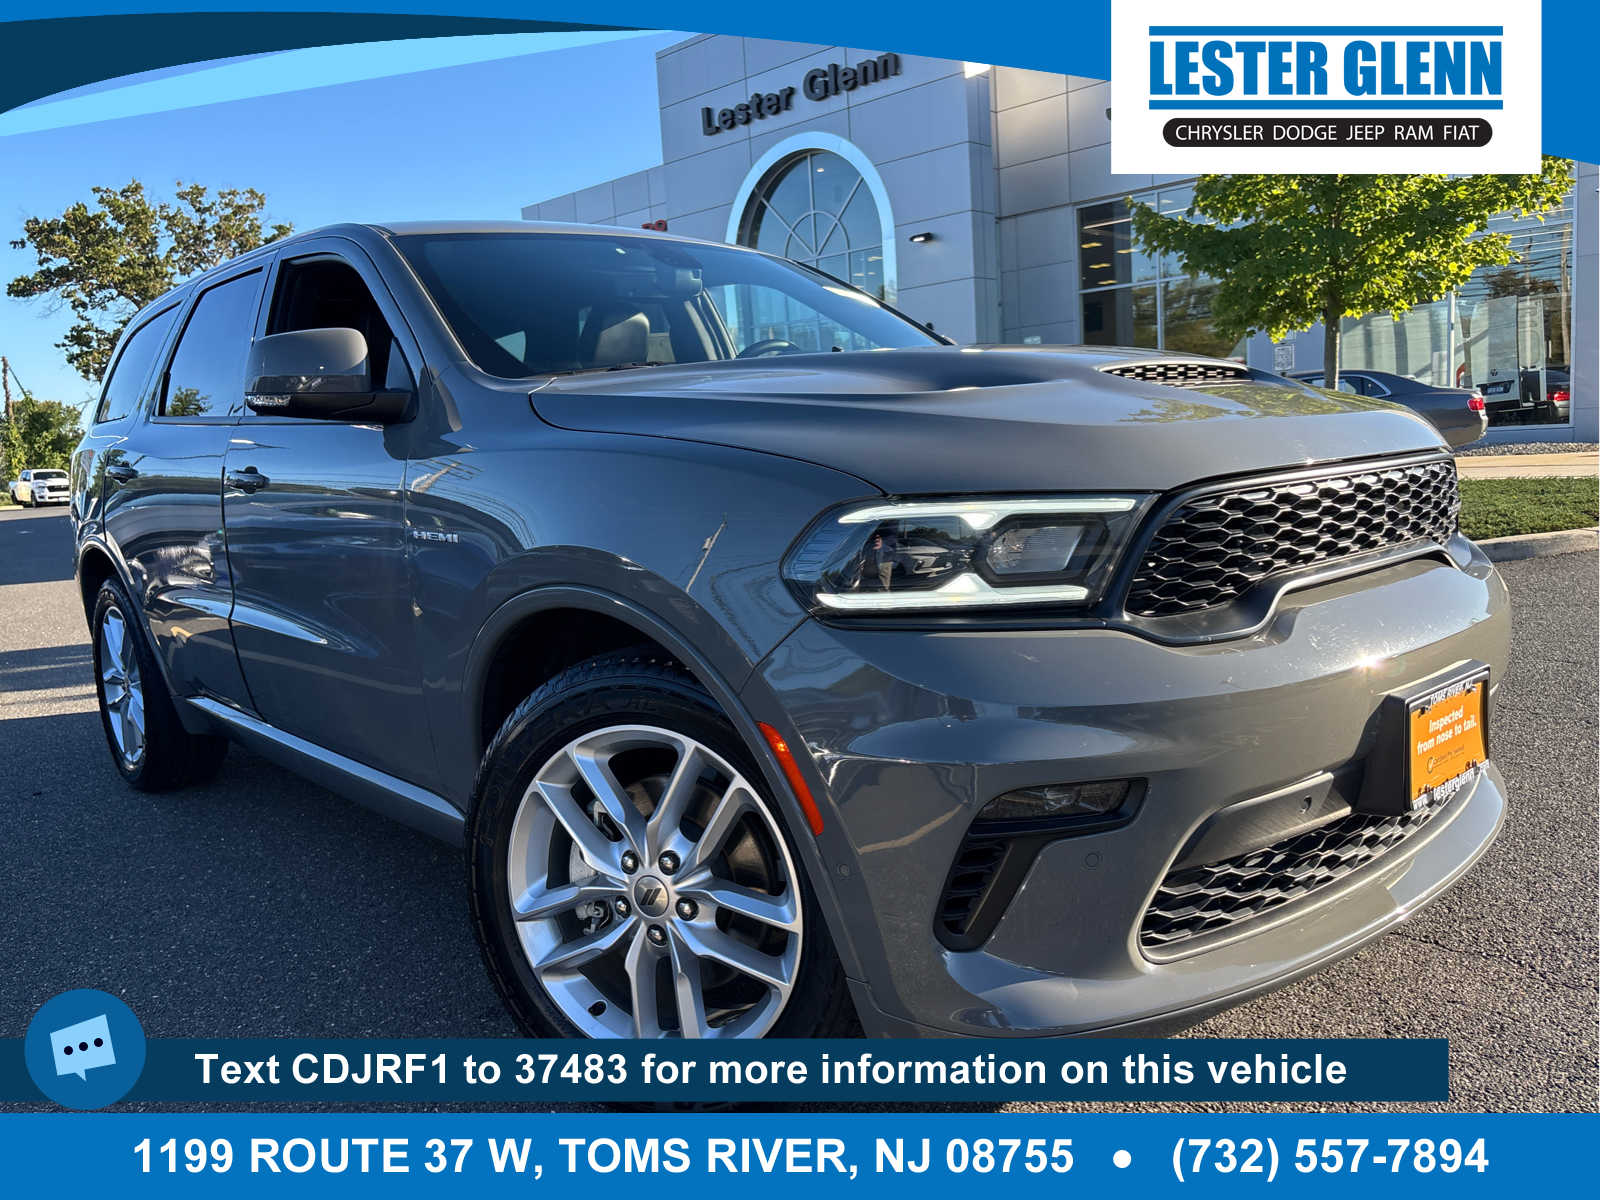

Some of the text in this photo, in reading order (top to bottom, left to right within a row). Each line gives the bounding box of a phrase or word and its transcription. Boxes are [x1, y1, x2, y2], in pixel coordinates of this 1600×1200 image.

[701, 53, 902, 136] Lester Glenn
[412, 530, 460, 543] HEMI
[1417, 714, 1477, 756] from nose to tail.
[1429, 704, 1464, 734] Inspected
